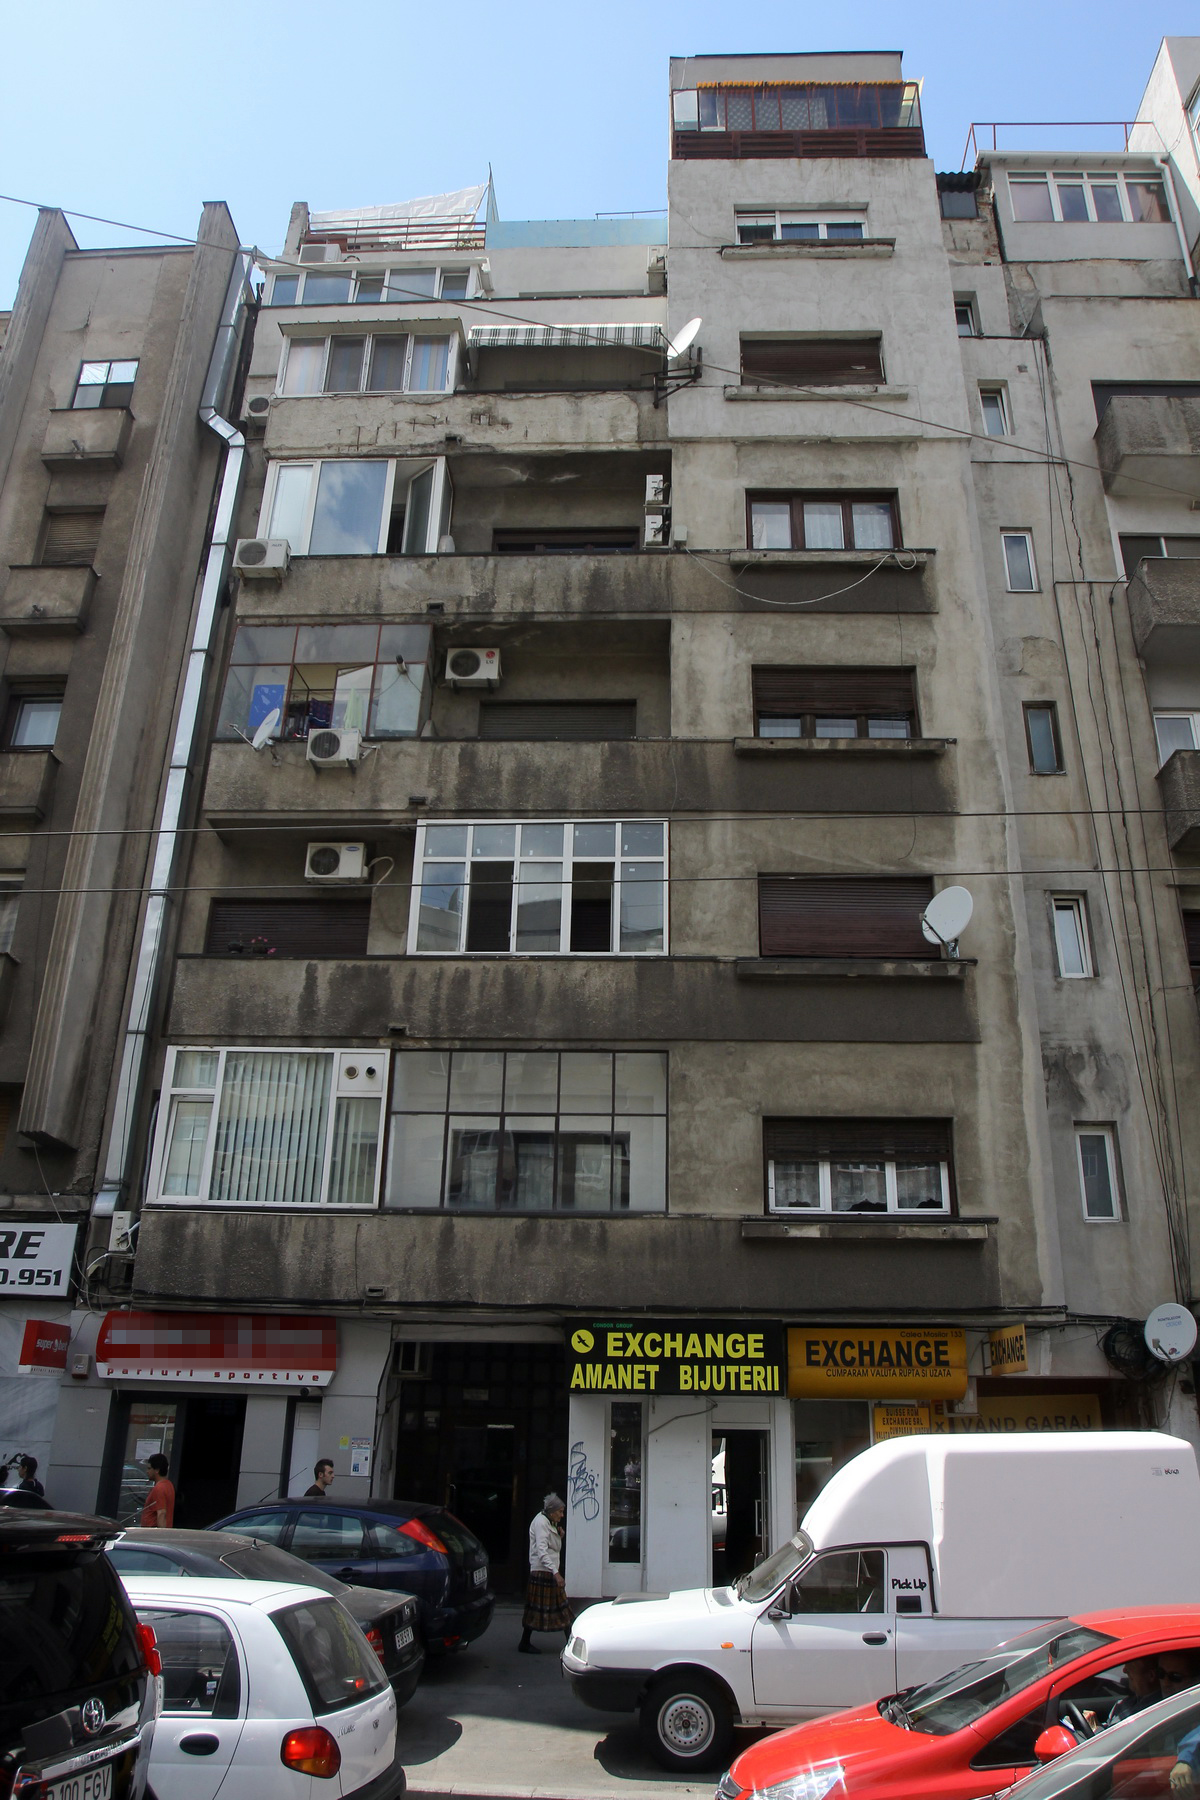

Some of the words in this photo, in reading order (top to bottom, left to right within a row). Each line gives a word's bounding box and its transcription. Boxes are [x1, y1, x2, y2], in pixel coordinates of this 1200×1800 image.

[900, 1330, 922, 1338] Calea
[923, 1330, 948, 1338] Mosilor
[606, 1332, 765, 1358] EXCHANGE
[805, 1340, 950, 1367] EXCHANGE
[990, 1335, 1025, 1366] EXCHANGE
[106, 1367, 194, 1378] pariuri
[214, 1370, 320, 1382] sportive
[570, 1363, 660, 1390] AMANET
[679, 1365, 780, 1391] BIJUTERII
[826, 1368, 869, 1378] CUMPARAM
[871, 1368, 897, 1378] VALUTA
[899, 1368, 921, 1378] RUPTA
[921, 1368, 929, 1378] SI
[929, 1368, 952, 1378] UZATA
[882, 1417, 912, 1426] EXCHANGE
[913, 1417, 924, 1426] SRL
[885, 1408, 906, 1417] SUISSE
[907, 1408, 920, 1417] ROM
[1025, 1414, 1092, 1432] GARAJ
[83, 1767, 111, 1800] FGV
